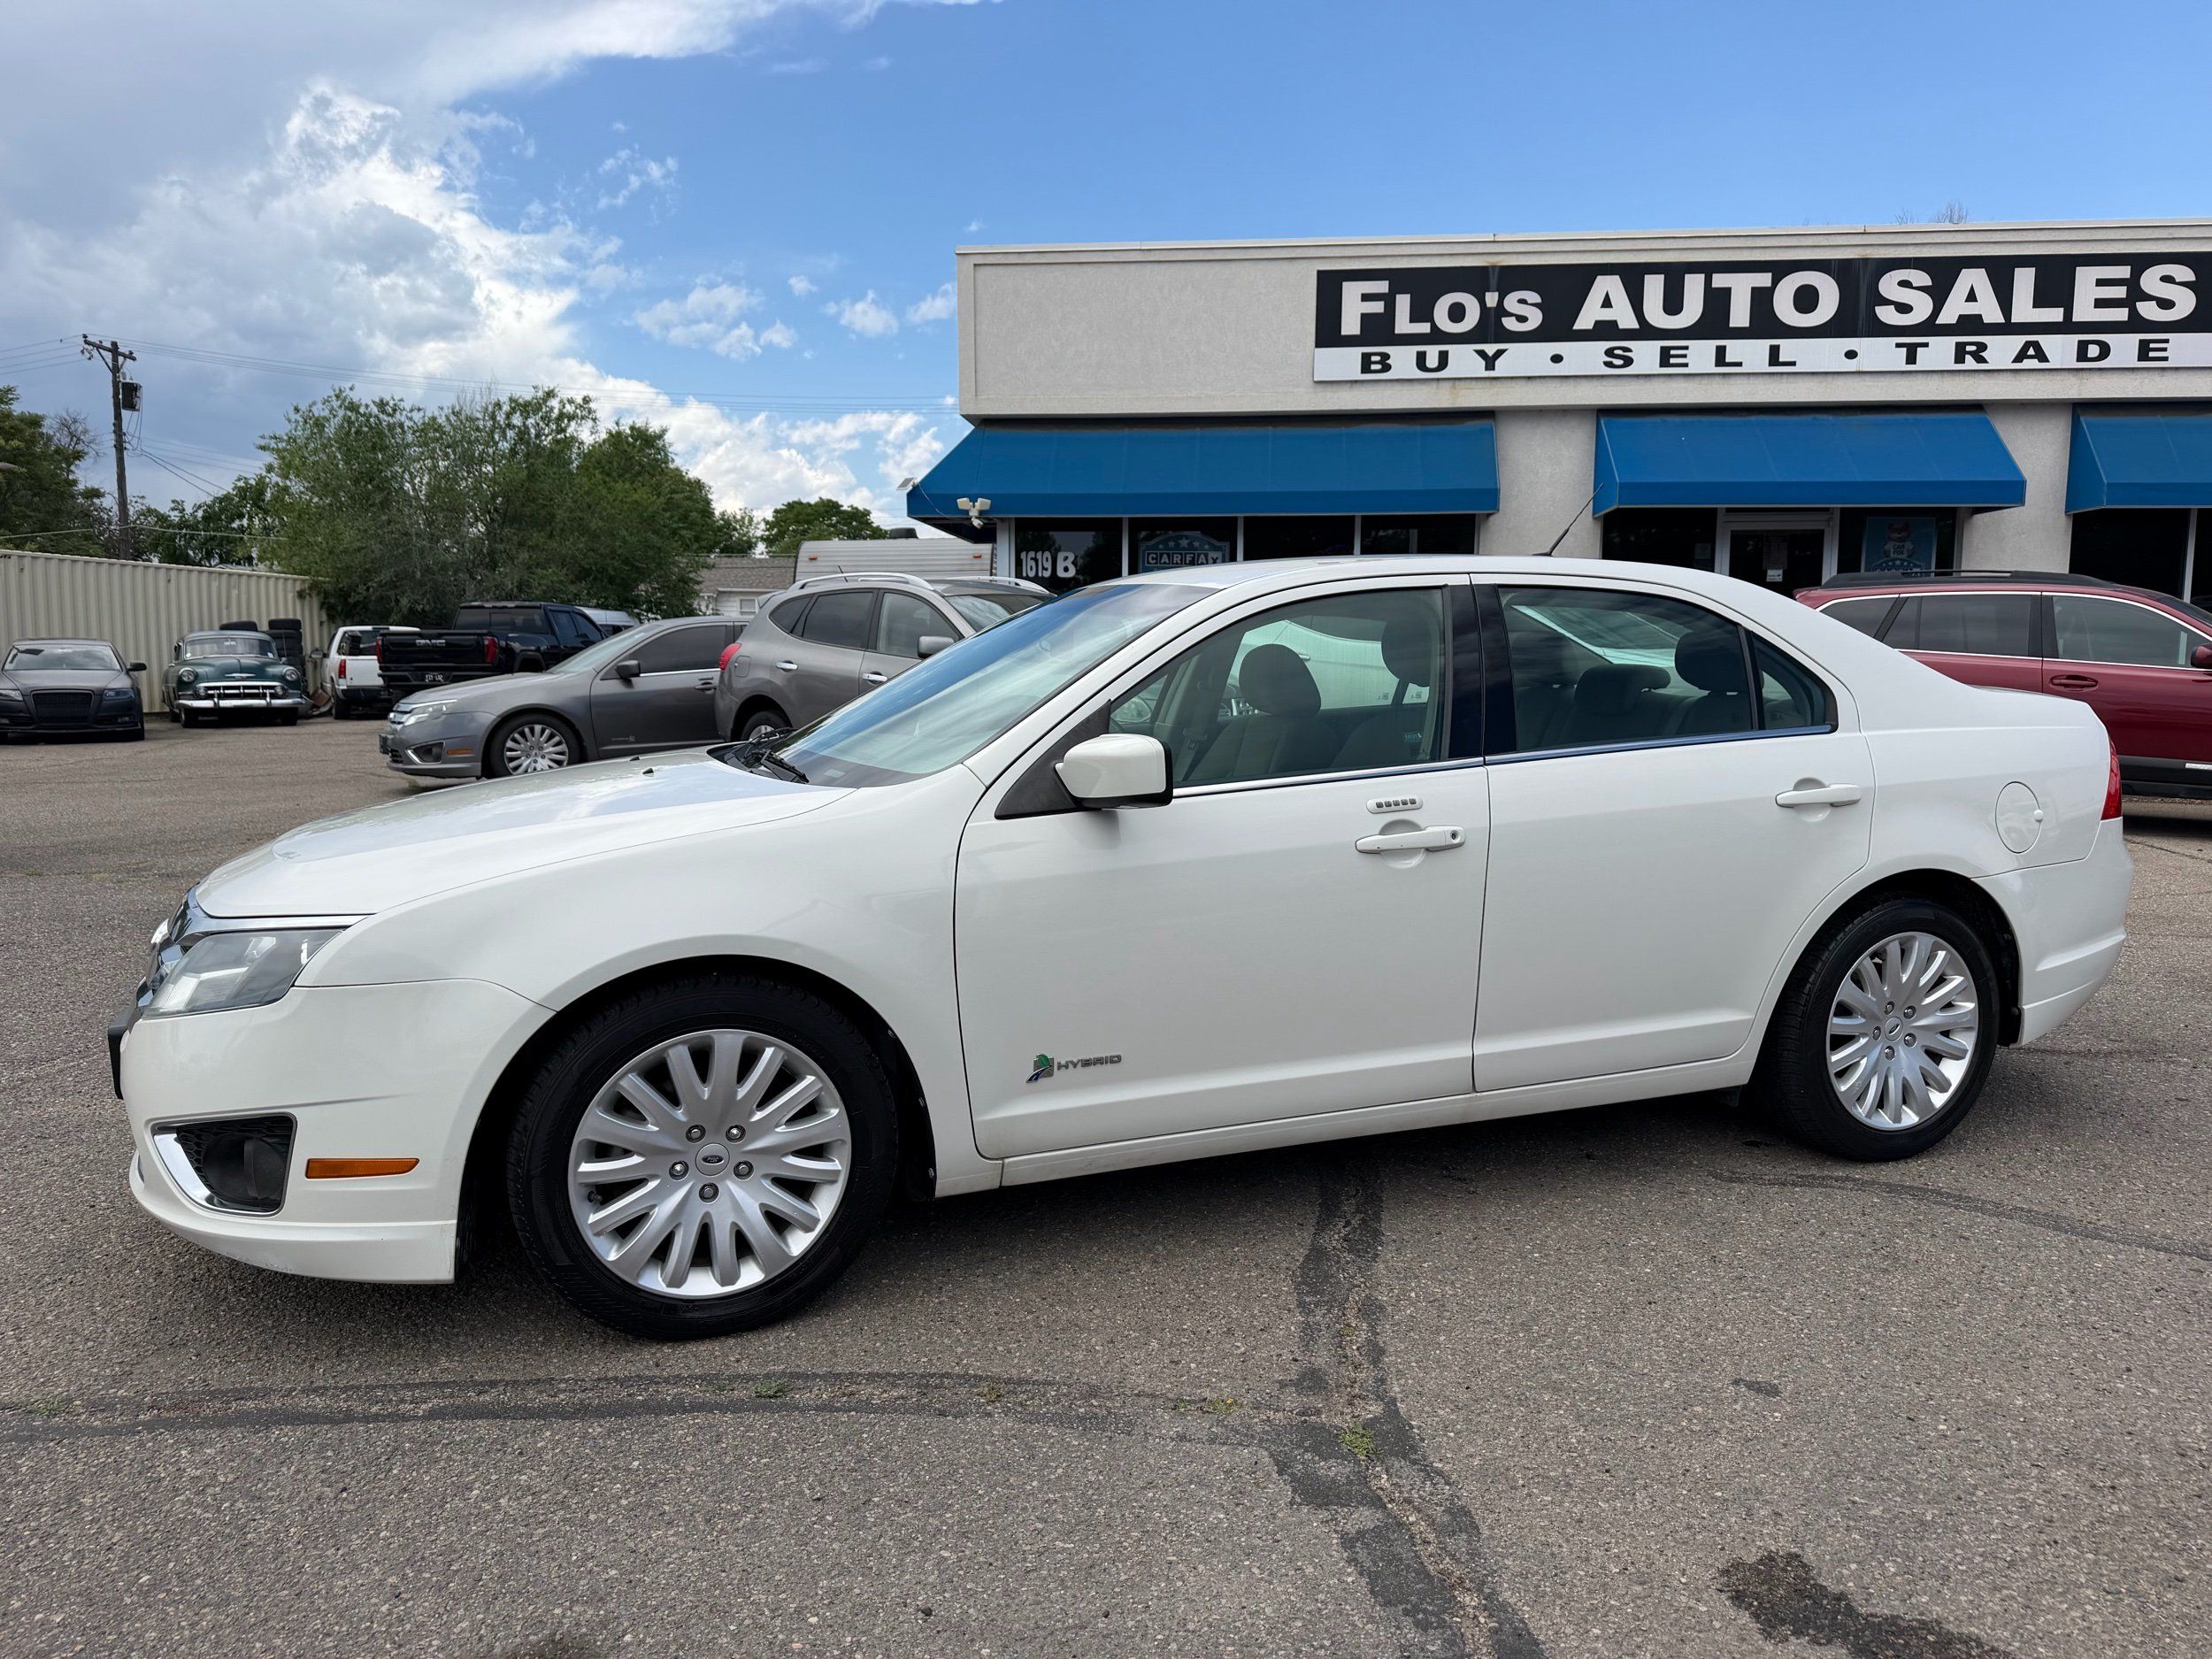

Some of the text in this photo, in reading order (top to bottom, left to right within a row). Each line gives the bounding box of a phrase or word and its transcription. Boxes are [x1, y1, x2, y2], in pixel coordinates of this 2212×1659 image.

[1572, 270, 1840, 330] AUTO
[1874, 264, 2198, 326] SALES
[1360, 339, 2170, 375] BUY SELL TRADE
[1020, 550, 1076, 578] 1619 B
[1056, 1054, 1122, 1071] HYBRID
